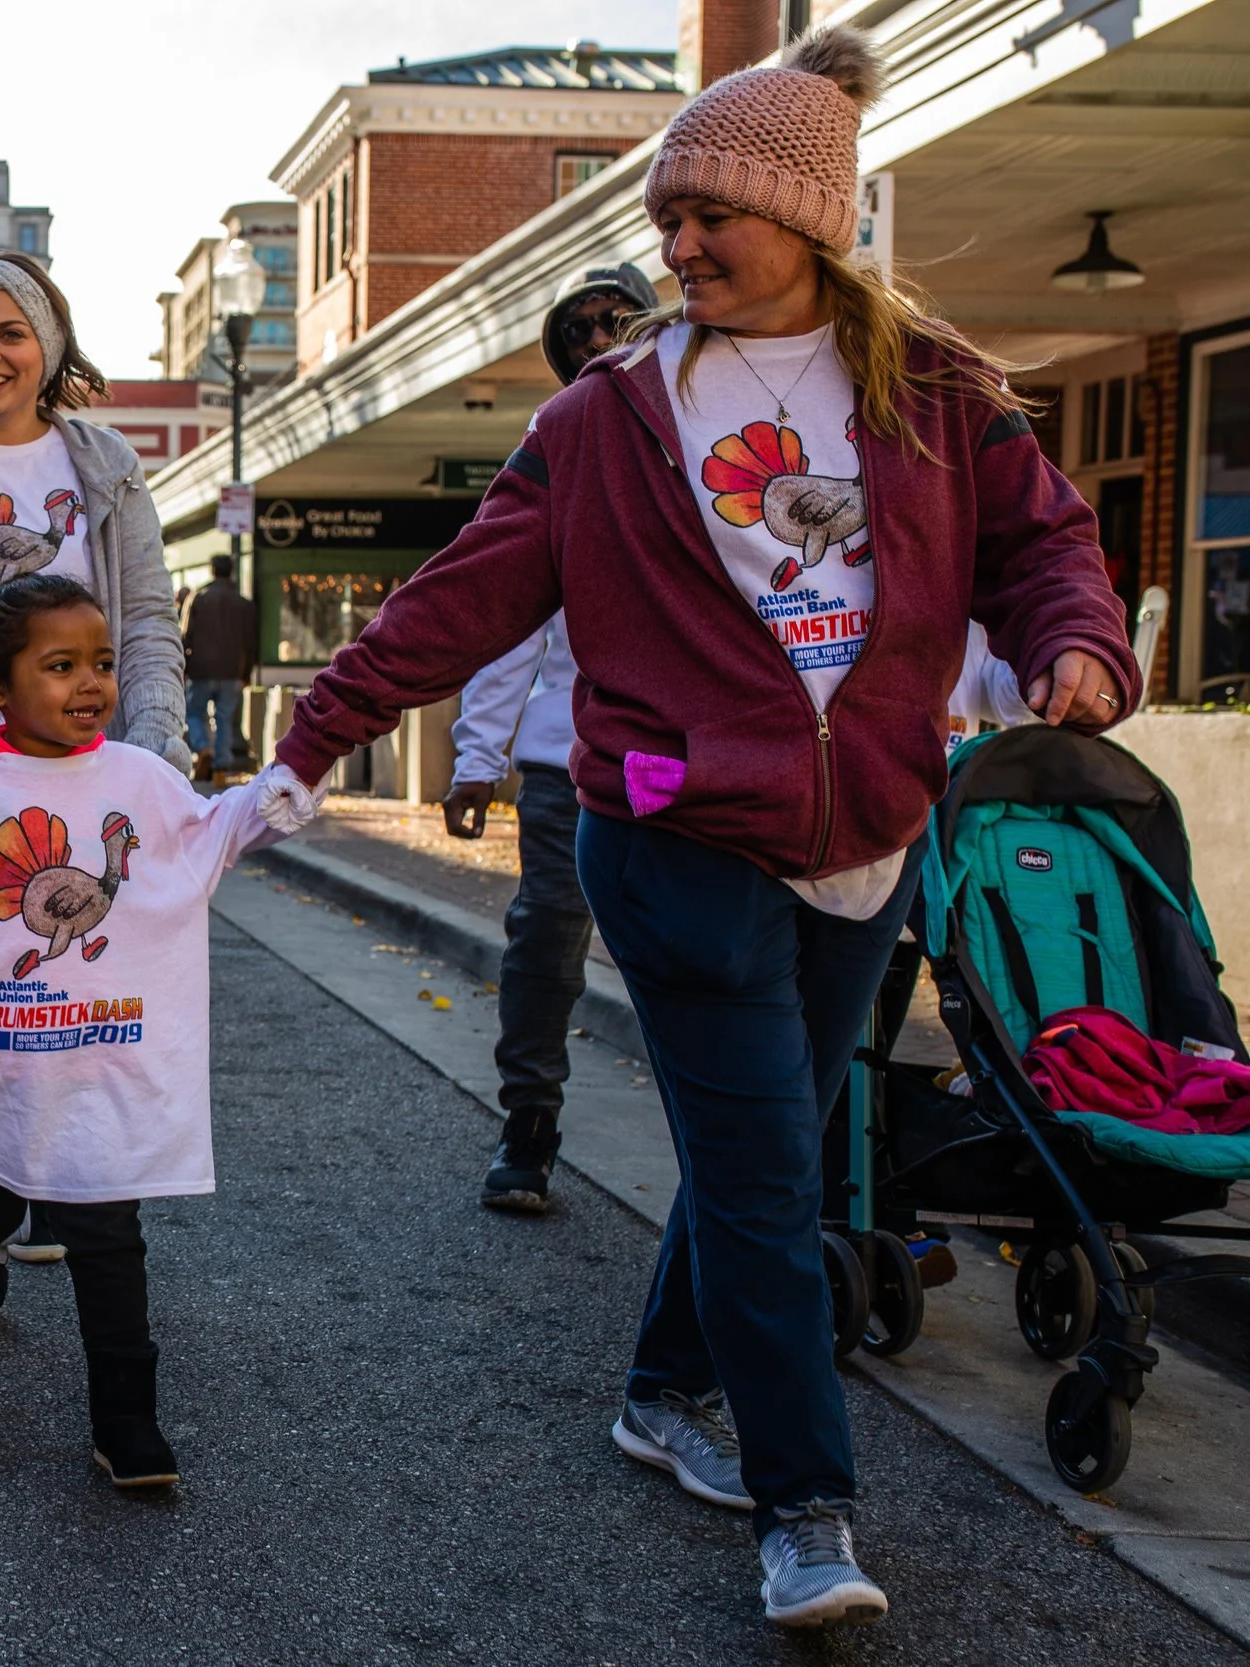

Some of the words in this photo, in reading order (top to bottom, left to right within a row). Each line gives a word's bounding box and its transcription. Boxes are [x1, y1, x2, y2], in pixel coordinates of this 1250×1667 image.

[306, 509, 345, 523] Great
[348, 509, 382, 524] Food
[312, 524, 329, 539] By
[330, 525, 376, 538] Choice
[757, 588, 820, 608] Atlantic
[758, 605, 804, 620] Union
[807, 597, 847, 613] Bank
[771, 608, 872, 646] UMSTICK
[794, 648, 820, 660] MOVE
[821, 644, 845, 657] YOUR
[794, 660, 805, 669] SO
[806, 656, 834, 667] OTHERS
[835, 653, 850, 663] CAN
[1021, 851, 1048, 867] chicco
[36, 990, 69, 1003] Bank
[91, 997, 143, 1022] DASH
[16, 1034, 39, 1043] MOVE
[40, 1032, 60, 1042] YOUR
[61, 1030, 79, 1040] FEET
[81, 1022, 143, 1046] 2019
[25, 1042, 49, 1050] OTHERS
[50, 1041, 63, 1049] CAN
